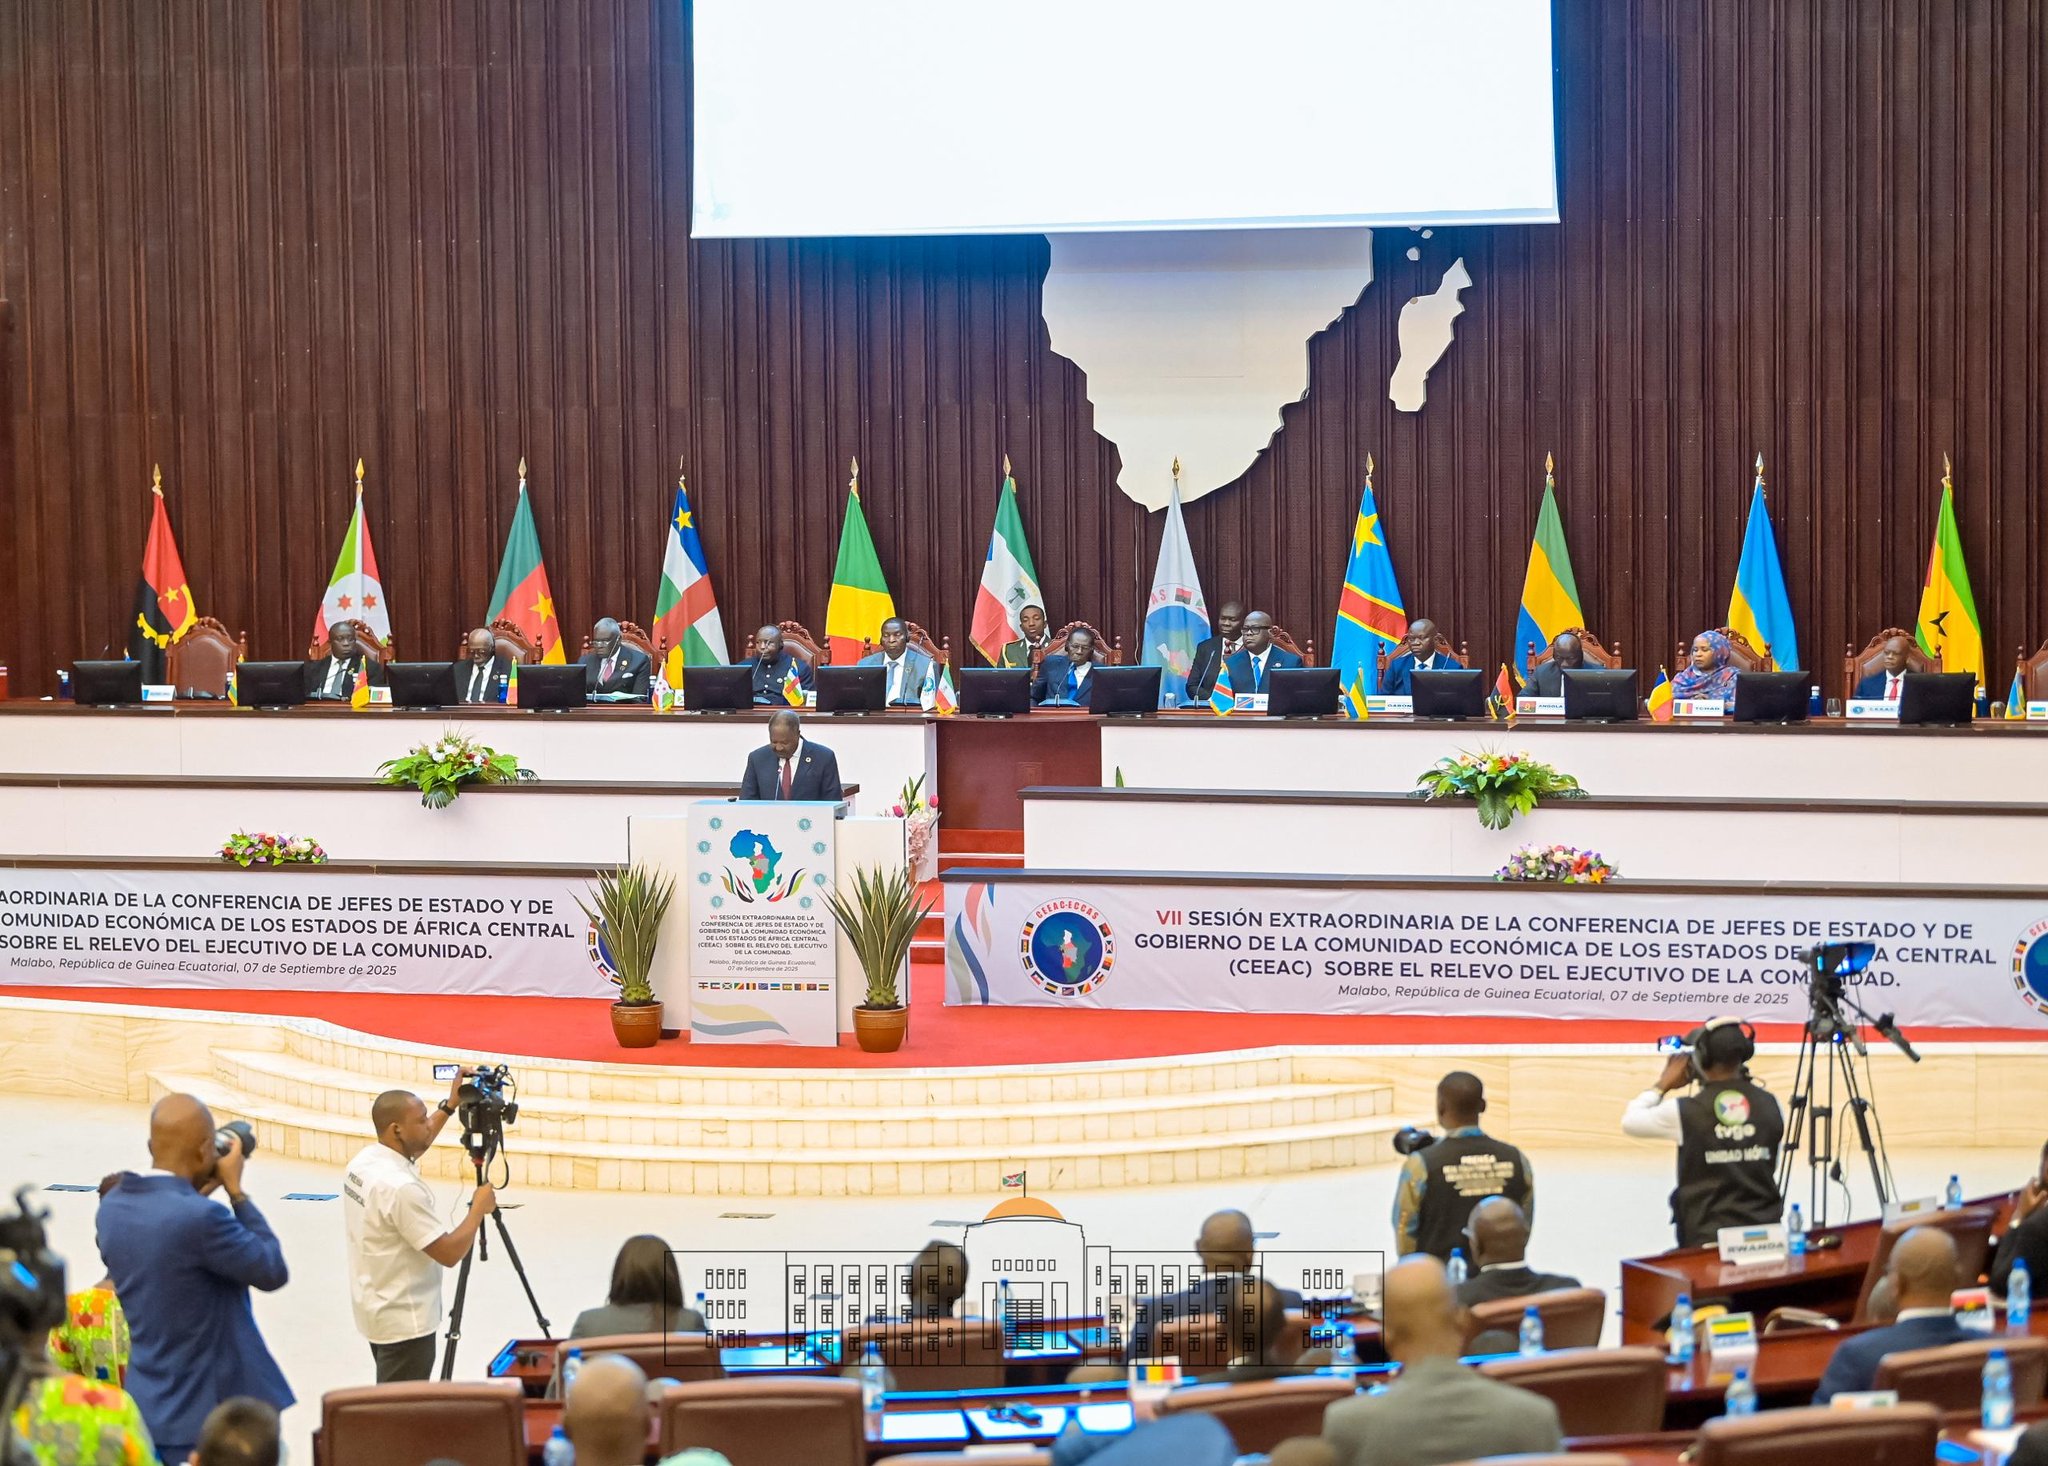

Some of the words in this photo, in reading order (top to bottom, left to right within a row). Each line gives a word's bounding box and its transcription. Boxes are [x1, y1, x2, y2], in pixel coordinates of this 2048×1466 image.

[0, 890, 109, 907] AORDINARIA
[115, 892, 138, 907] DE
[144, 893, 166, 908] LA
[172, 893, 302, 910] CONFERENCIA
[308, 896, 332, 911] DE
[338, 896, 392, 912] JEFES
[399, 897, 423, 912] DE
[429, 898, 504, 914] ESTADO
[510, 899, 522, 914] Y
[528, 900, 553, 915] DE
[1035, 900, 1100, 921] CEEAC-ECCAS
[1, 912, 99, 928] OMUNIDAD
[105, 912, 216, 931] ECONÓMICA
[221, 917, 245, 932] DE
[251, 917, 286, 933] LOS
[292, 918, 377, 934] ESTADOS
[383, 920, 408, 935] DE
[413, 916, 482, 936] ÁFRICA
[488, 921, 575, 938] CENTRAL
[1156, 910, 1181, 925] VII
[1188, 908, 1262, 927] SESIÓN
[1270, 912, 1454, 930] EXTRAORDINARIA
[1461, 915, 1488, 931] DE
[1496, 916, 1521, 932] LA
[1528, 916, 1679, 934] CONFERENCIA
[1687, 919, 1714, 935] DE
[1722, 920, 1785, 936] JEFES
[1793, 921, 1821, 937] DE
[1829, 921, 1915, 938] ESTADO
[1923, 923, 1936, 938] Y
[1944, 923, 1972, 939] DE
[0, 934, 57, 950] SOBRE
[63, 936, 84, 951] EL
[89, 936, 160, 952] RELEVO
[166, 938, 200, 953] DEL
[206, 939, 307, 956] EJECUTIVO
[313, 941, 337, 956] DE
[343, 942, 366, 957] LA
[372, 942, 492, 960] COMUNIDAD.
[1135, 933, 1242, 951] GOBIERNO
[1249, 935, 1275, 951] DE
[1282, 936, 1308, 952] LA
[1314, 936, 1443, 954] COMUNIDAD
[1450, 936, 1578, 956] ECONÓMICA
[1586, 942, 1613, 957] DE
[1620, 942, 1661, 958] LOS
[1668, 943, 1767, 960] ESTADOS
[1775, 945, 1802, 961] DE
[1896, 947, 1996, 965] CENTRAL
[10, 957, 55, 969] Malabo,
[59, 958, 115, 970] República
[118, 959, 132, 970] de
[136, 959, 175, 971] Guinea
[178, 960, 239, 974] Ecuatorial,
[243, 962, 259, 973] 07
[262, 963, 276, 974] de
[279, 963, 345, 976] Septiembre
[348, 964, 363, 975] de
[366, 964, 397, 976] 2025
[1229, 959, 1312, 978] (CEEAC)
[1324, 960, 1393, 977] SOBRE
[1400, 962, 1424, 977] EL
[1431, 963, 1513, 980] RELEVO
[1520, 964, 1560, 980] DEL
[1567, 965, 1684, 983] EJECUTIVO
[1692, 968, 1720, 983] DE
[1727, 968, 1753, 984] LA
[1761, 969, 1901, 987] COMIDAD.
[1338, 985, 1390, 998] Malabo,
[1395, 985, 1460, 999] República
[1463, 987, 1480, 998] de
[1484, 987, 1530, 999] Guinea
[1534, 988, 1605, 1002] Ecuatorial,
[1610, 990, 1628, 1001] 07
[1632, 991, 1649, 1002] de
[1652, 991, 1729, 1004] Septiembre
[1733, 993, 1750, 1004] de
[1754, 993, 1789, 1005] 2025
[1728, 1241, 1784, 1253] RWANDA
